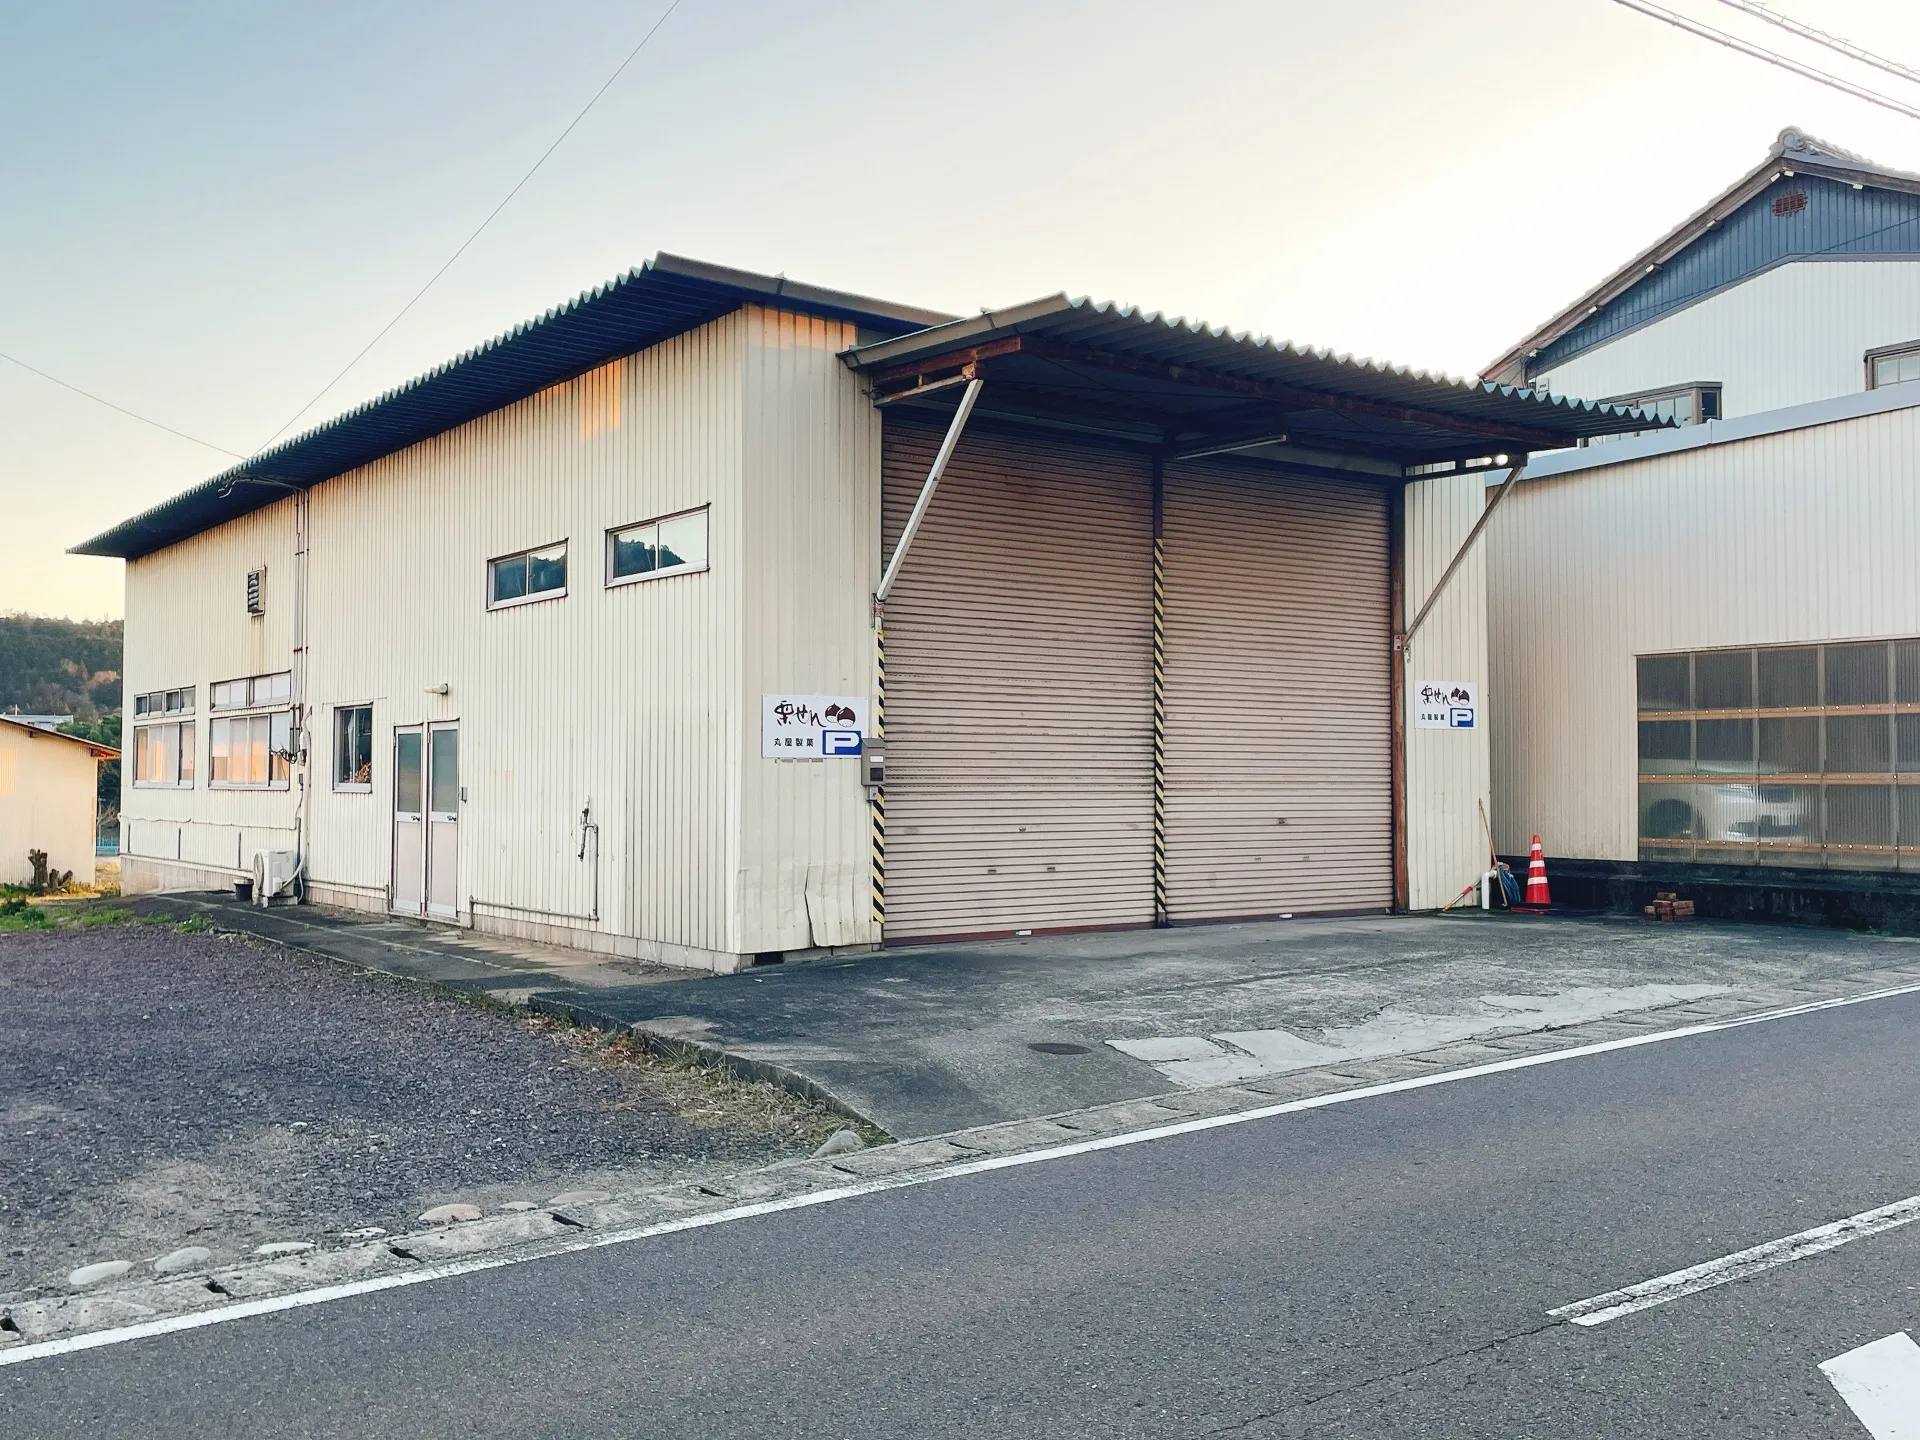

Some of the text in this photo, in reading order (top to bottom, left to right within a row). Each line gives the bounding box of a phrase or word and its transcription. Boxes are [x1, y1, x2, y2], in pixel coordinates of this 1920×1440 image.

[1452, 709, 1472, 726] P
[774, 737, 814, 747] 丸屋製菓
[826, 732, 859, 753] P
